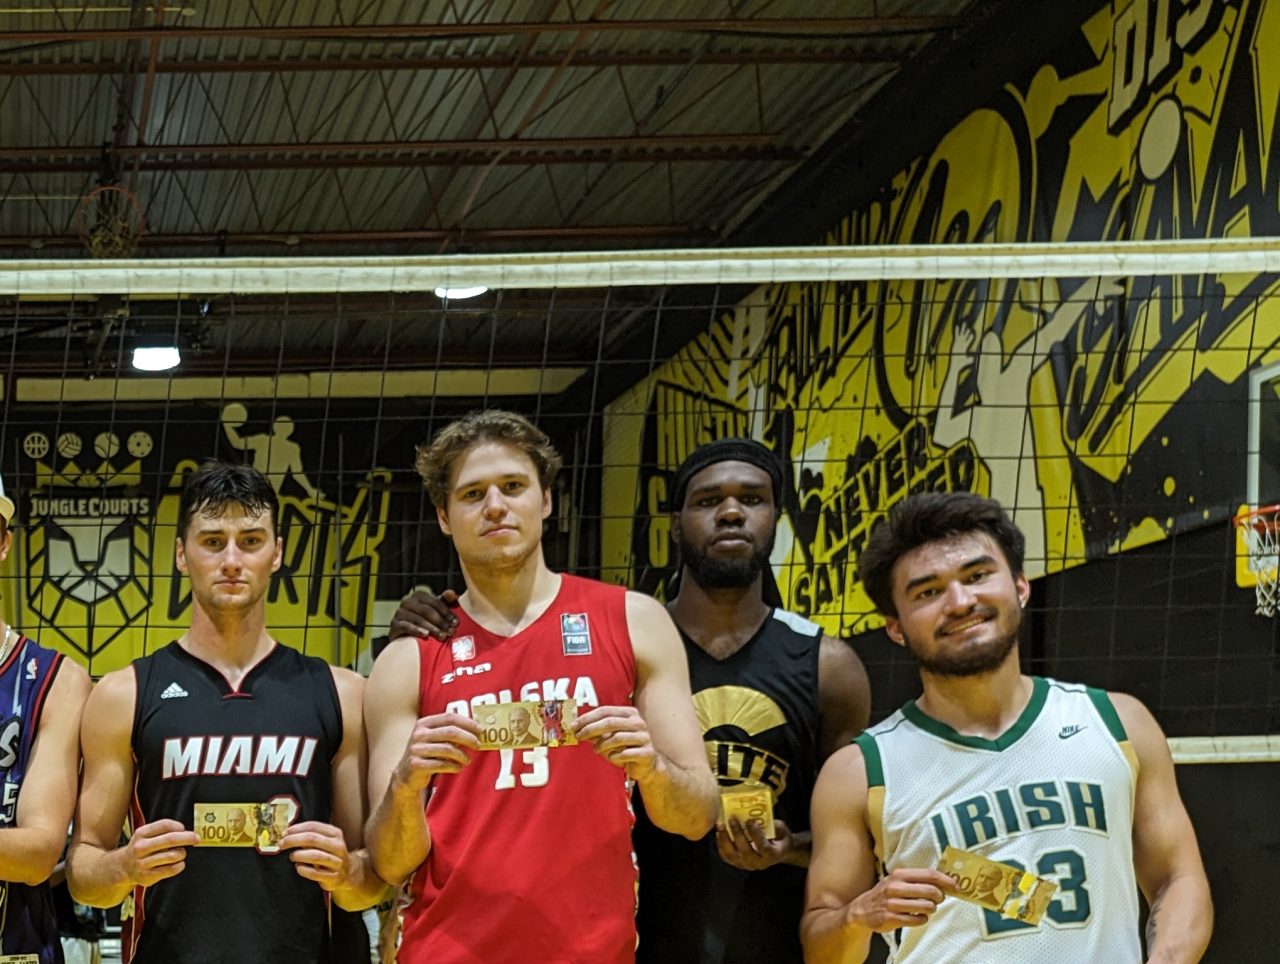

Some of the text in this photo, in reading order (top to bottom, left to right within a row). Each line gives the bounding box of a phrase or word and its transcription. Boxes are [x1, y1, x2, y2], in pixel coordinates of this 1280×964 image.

[566, 636, 586, 645] FIBA
[161, 690, 189, 699] adidas
[482, 727, 510, 743] 100
[162, 736, 319, 780] MIAMI
[930, 780, 1109, 856] IRISH
[201, 826, 226, 840] 100
